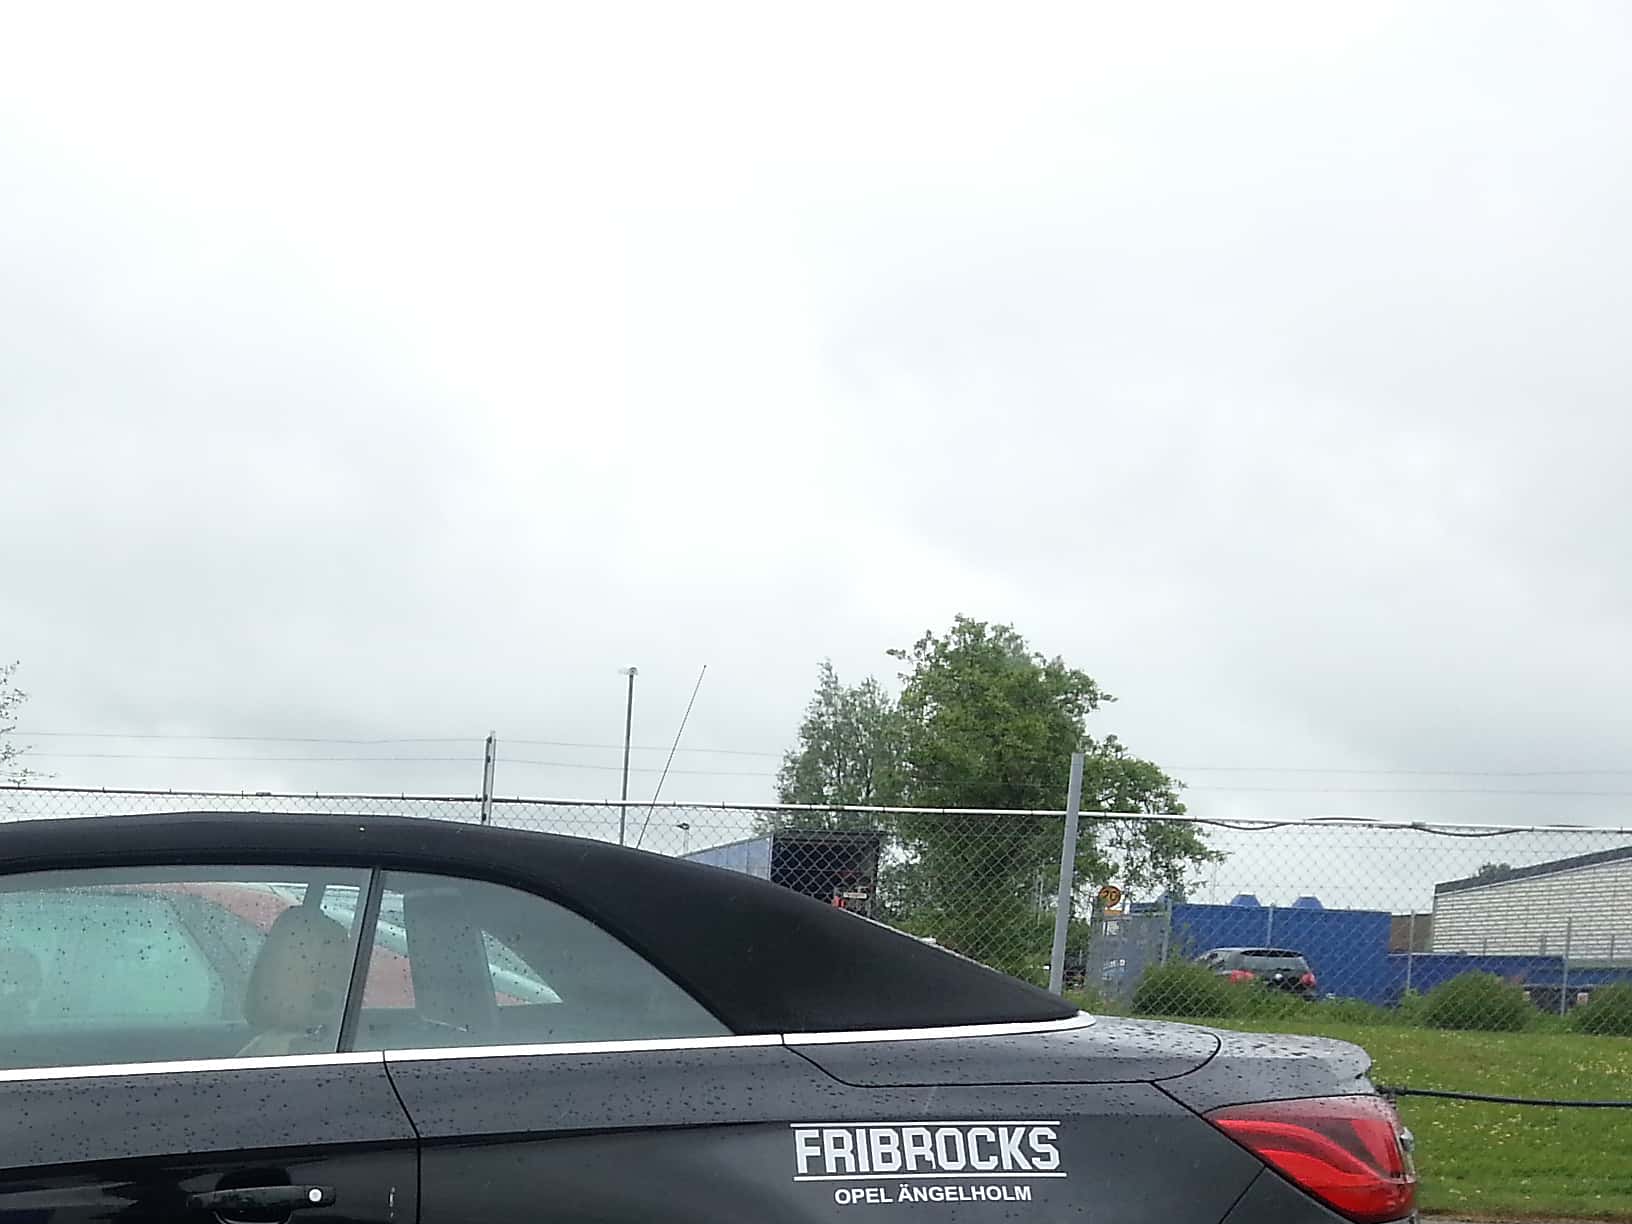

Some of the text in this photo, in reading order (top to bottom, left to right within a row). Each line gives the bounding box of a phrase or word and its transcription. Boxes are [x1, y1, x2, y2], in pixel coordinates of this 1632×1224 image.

[793, 1126, 1062, 1174] FRIBROCKS
[834, 1183, 1033, 1205] OPEL ÄNGELHOLM
